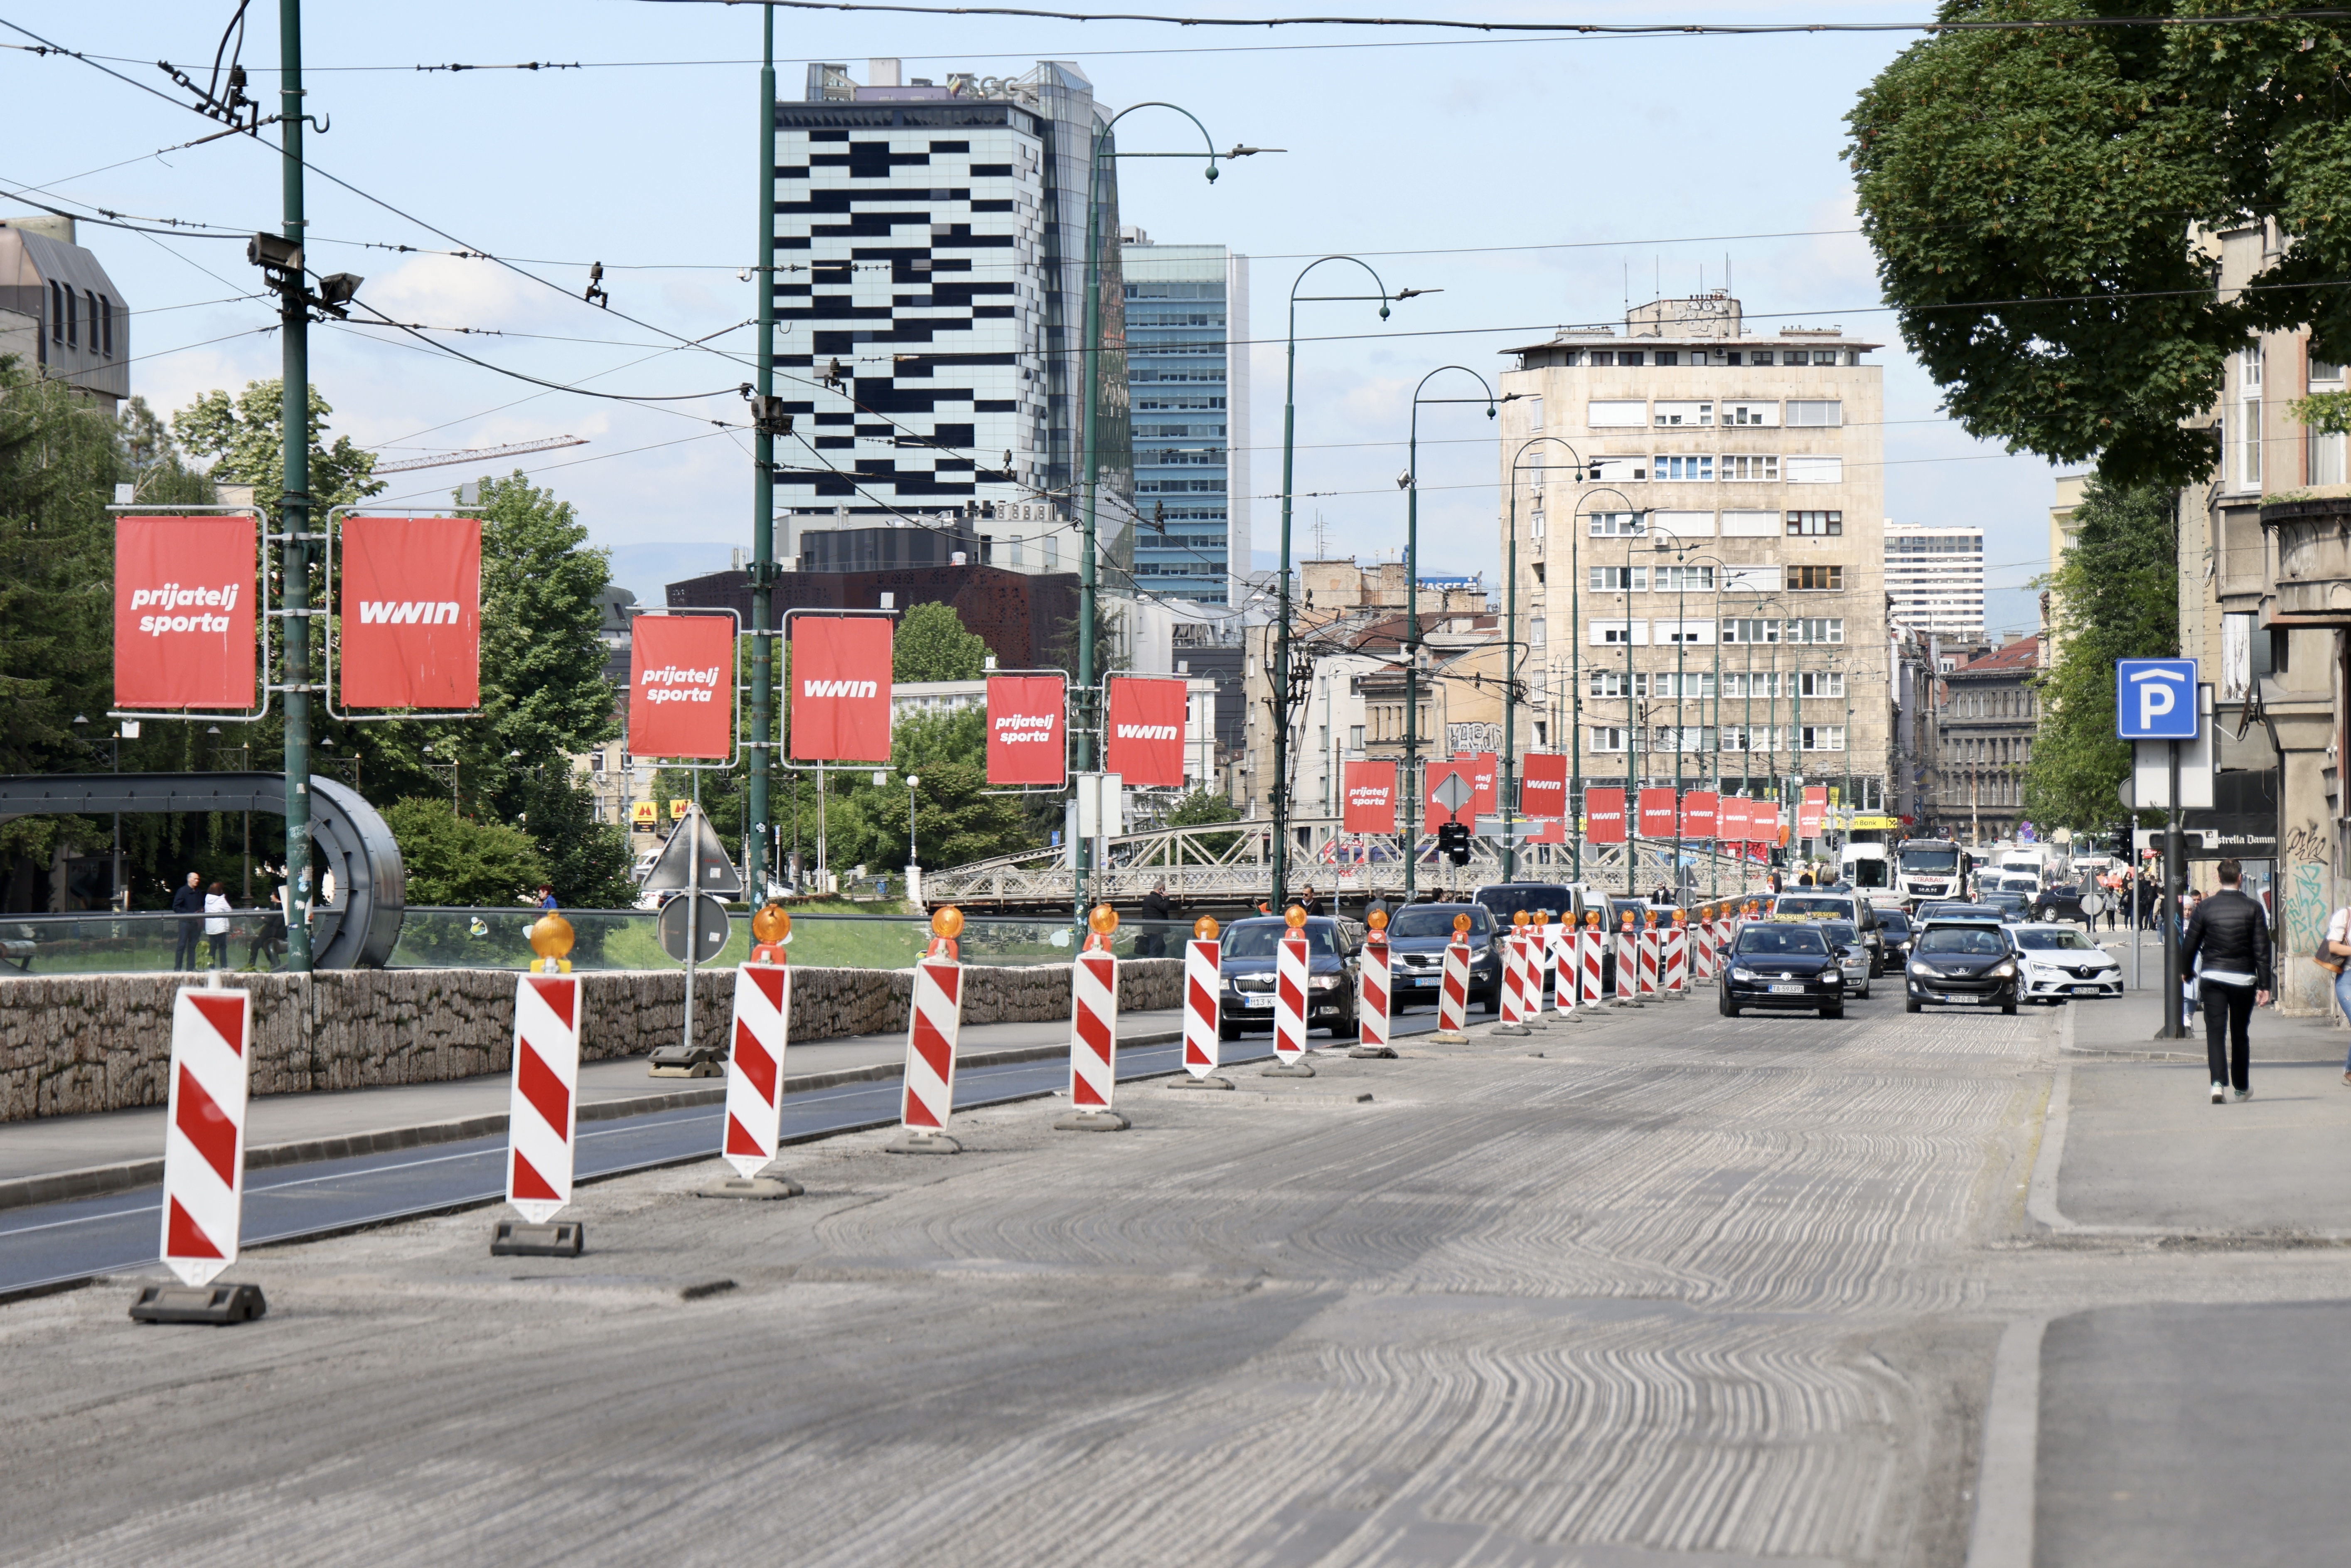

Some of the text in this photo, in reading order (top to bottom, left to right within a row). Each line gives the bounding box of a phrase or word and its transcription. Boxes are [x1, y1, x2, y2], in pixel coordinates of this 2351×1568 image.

[965, 76, 1019, 98] SCC
[130, 583, 239, 611] prijatelj
[359, 601, 460, 624] wwin
[139, 612, 230, 637] sporta
[641, 666, 719, 687] prijatelj
[647, 687, 712, 704] sporta
[804, 680, 877, 698] wwin
[2140, 683, 2175, 729] P
[995, 714, 1054, 730] prijatelj
[1000, 730, 1050, 745] sporta
[1117, 724, 1178, 740] wwin
[1349, 786, 1389, 798] prijatelj
[1527, 779, 1562, 790] wwin
[1352, 797, 1386, 806] sporta
[1591, 812, 1621, 820] wwin
[2218, 834, 2277, 844] strella Damm
